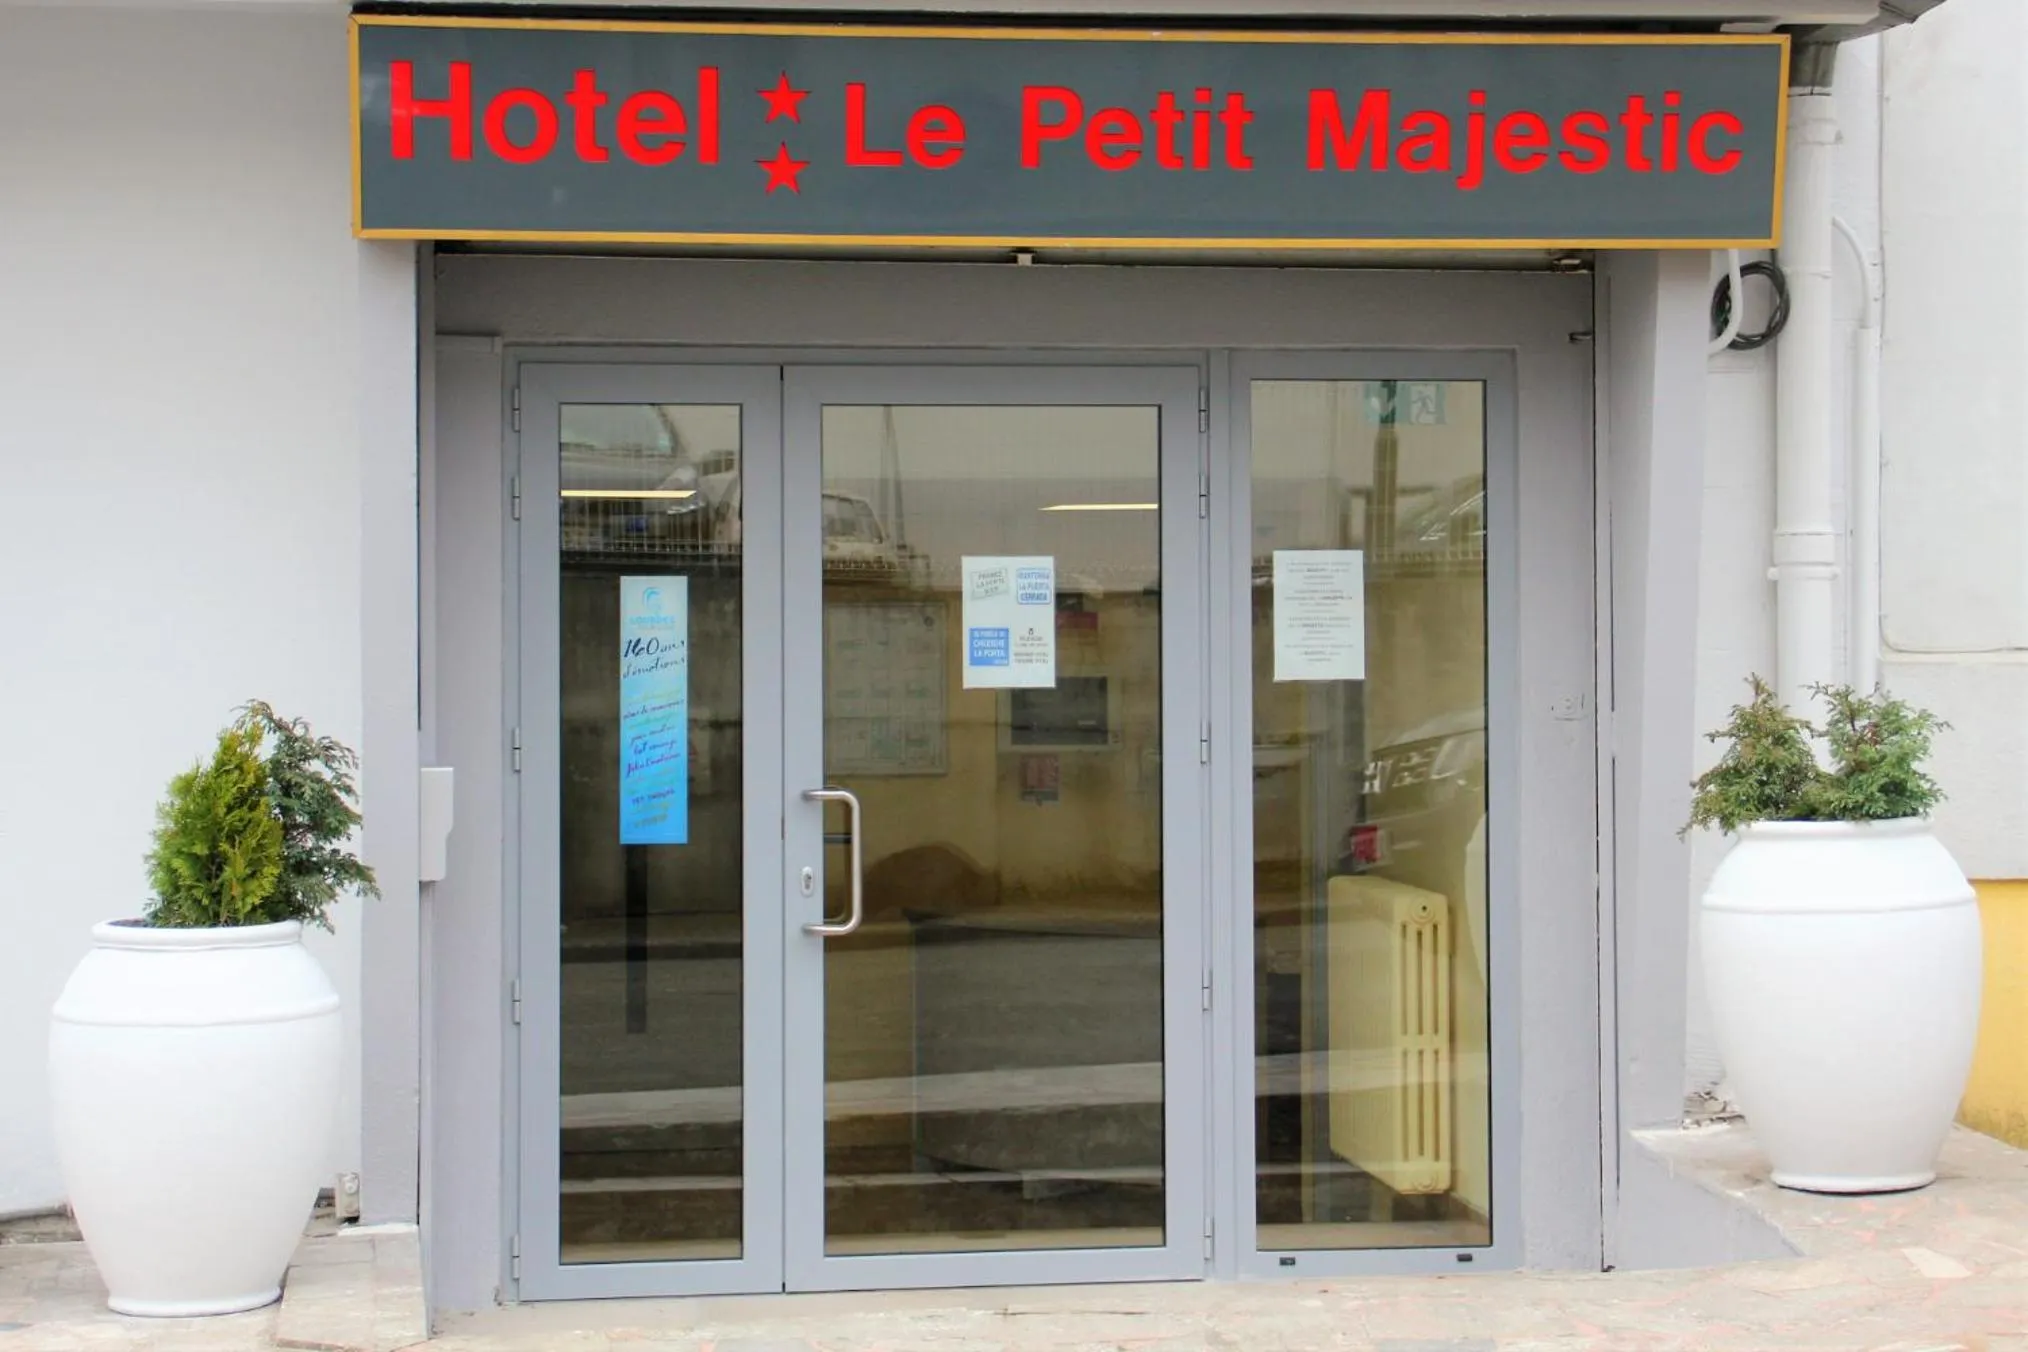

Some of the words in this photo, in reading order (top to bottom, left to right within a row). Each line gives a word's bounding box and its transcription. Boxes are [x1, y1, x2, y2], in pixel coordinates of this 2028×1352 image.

[390, 60, 720, 165] Hotel
[845, 82, 966, 169] Le
[1021, 85, 1254, 172] Petit
[1307, 88, 1744, 191] Majestic
